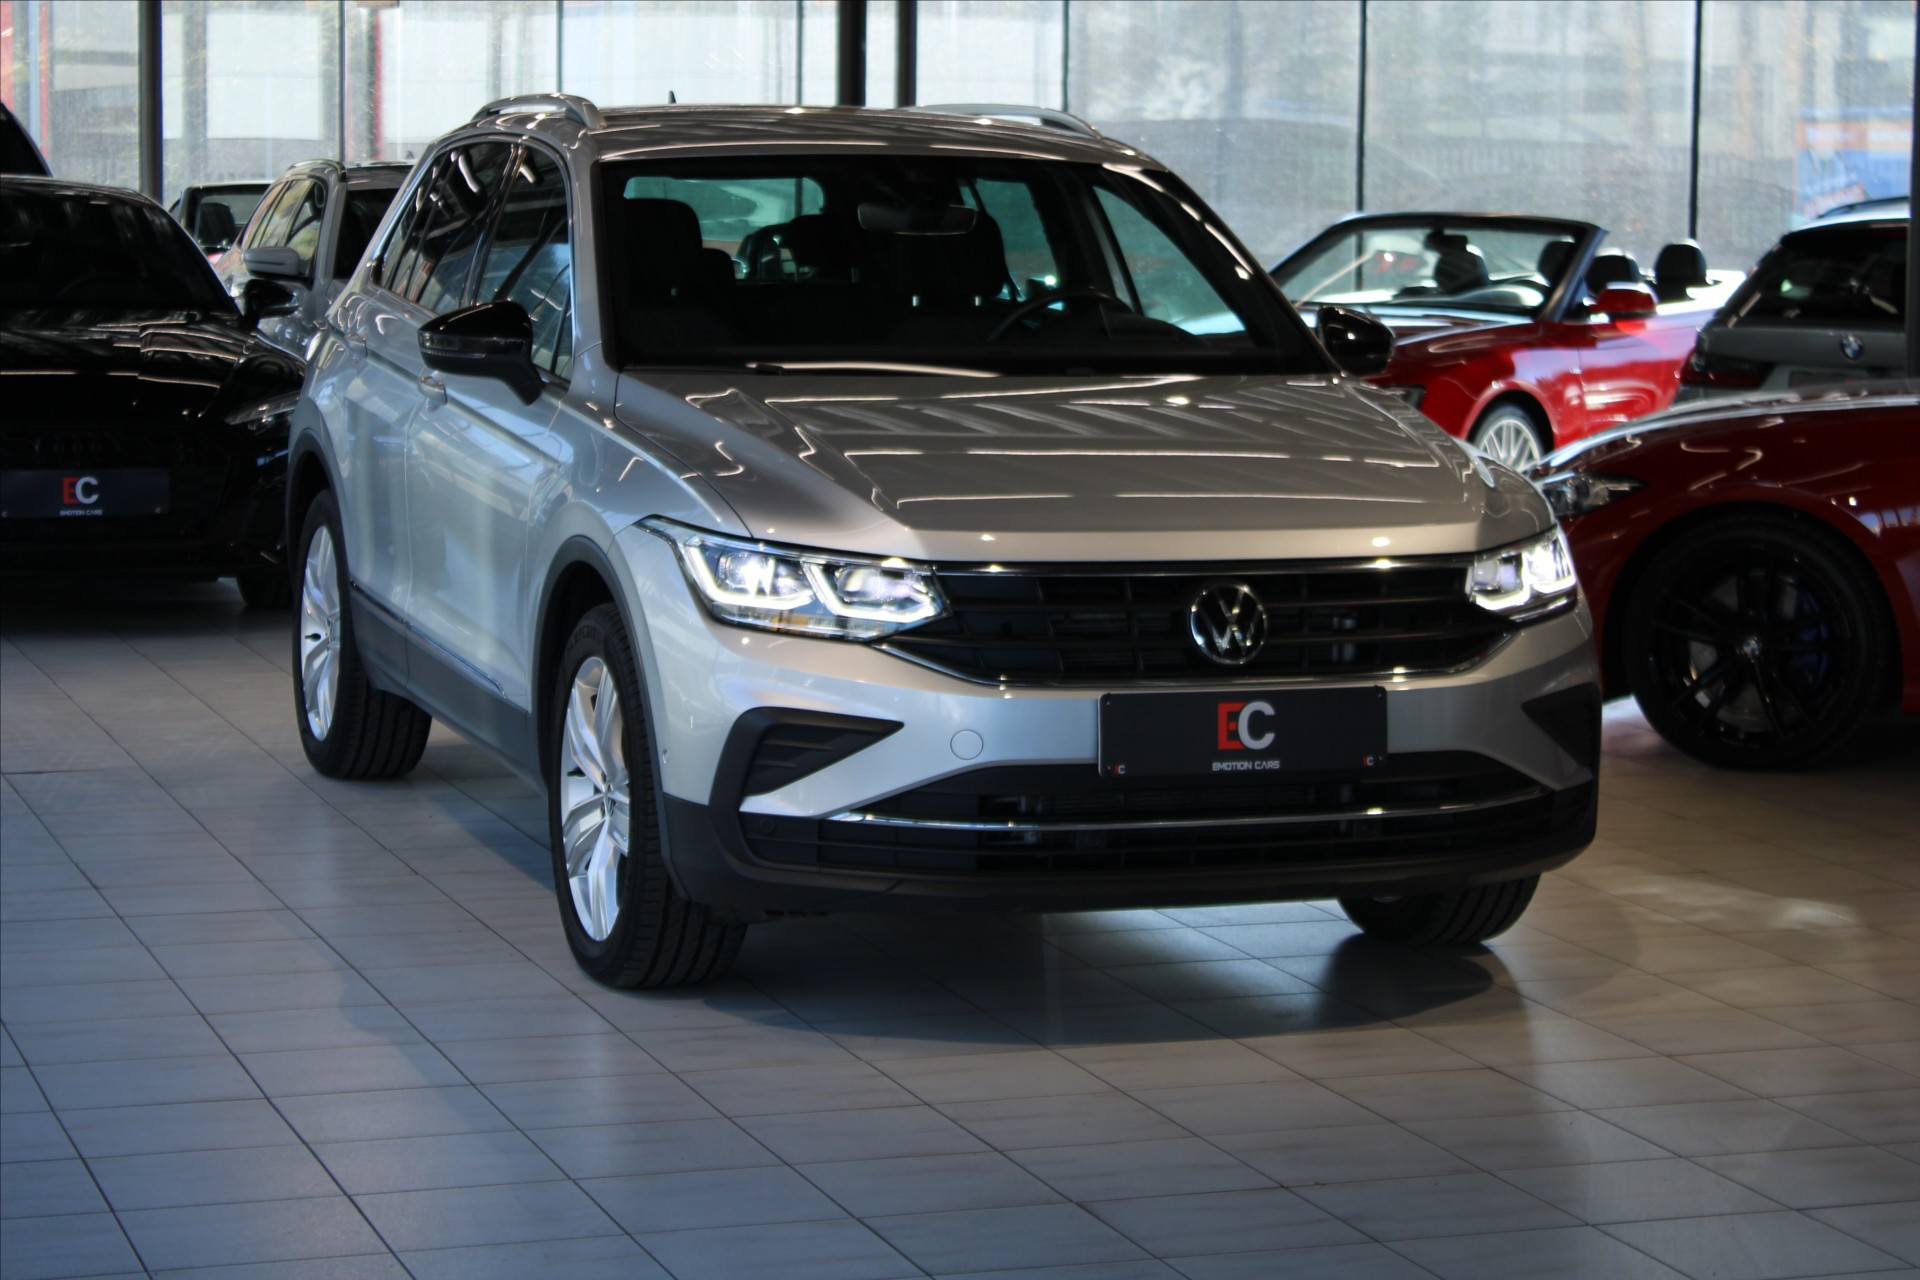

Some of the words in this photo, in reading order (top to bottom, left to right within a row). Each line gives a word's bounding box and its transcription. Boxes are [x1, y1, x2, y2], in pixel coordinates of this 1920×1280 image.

[62, 476, 99, 504] EC
[1217, 701, 1275, 751] EC
[1212, 762, 1252, 772] EMOTION
[1254, 760, 1280, 770] CARS
